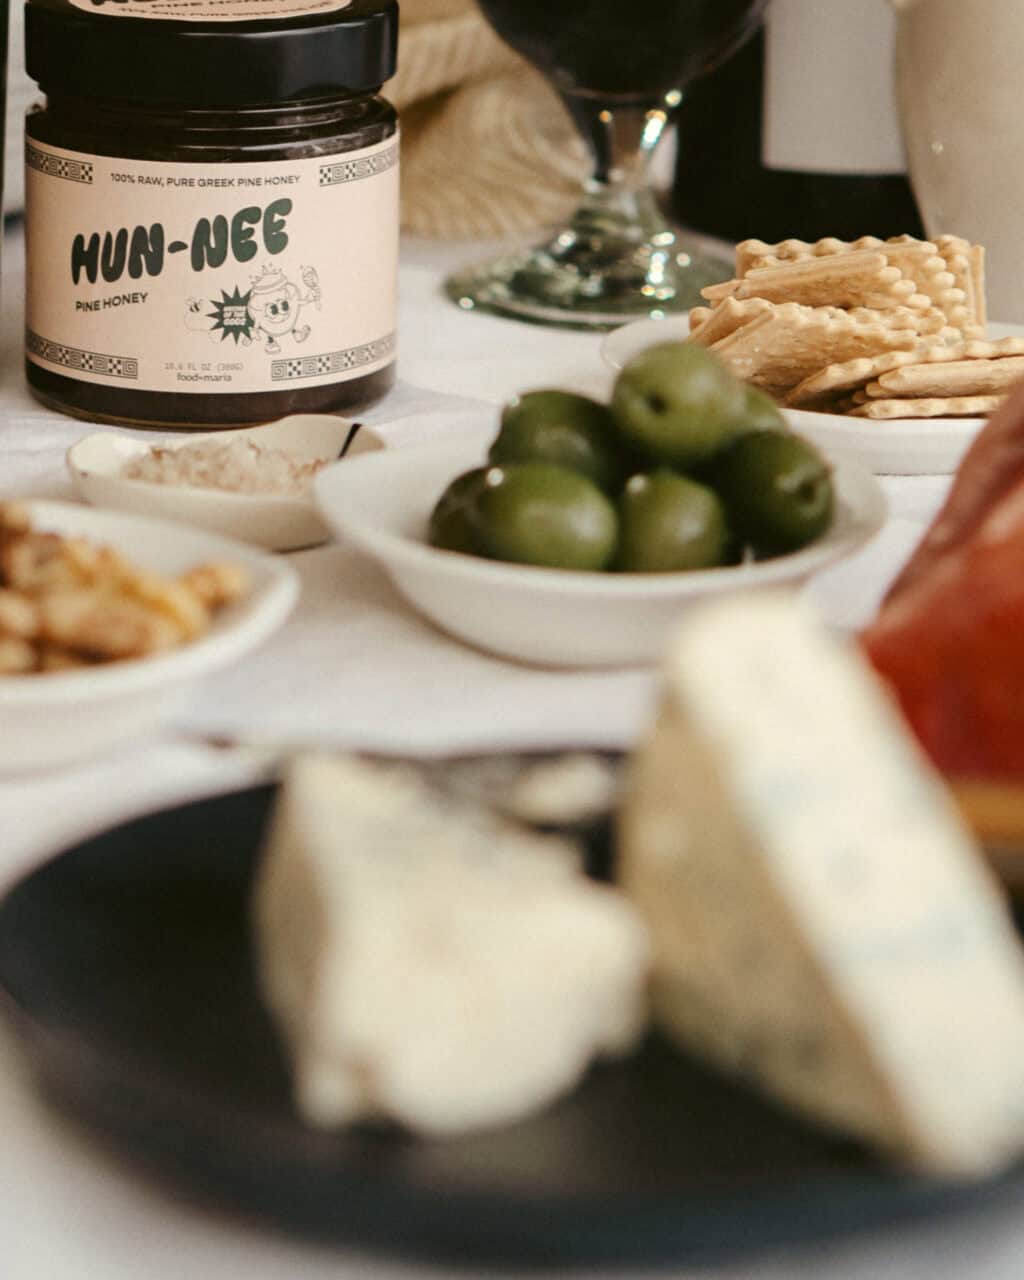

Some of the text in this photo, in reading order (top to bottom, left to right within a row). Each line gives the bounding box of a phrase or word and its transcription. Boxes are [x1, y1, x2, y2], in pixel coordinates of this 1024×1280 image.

[110, 172, 301, 188] 100% RAW, PURE GREEK PINE HONEY
[71, 197, 294, 286] HUN-NEE
[75, 291, 149, 313] PINE HONEY
